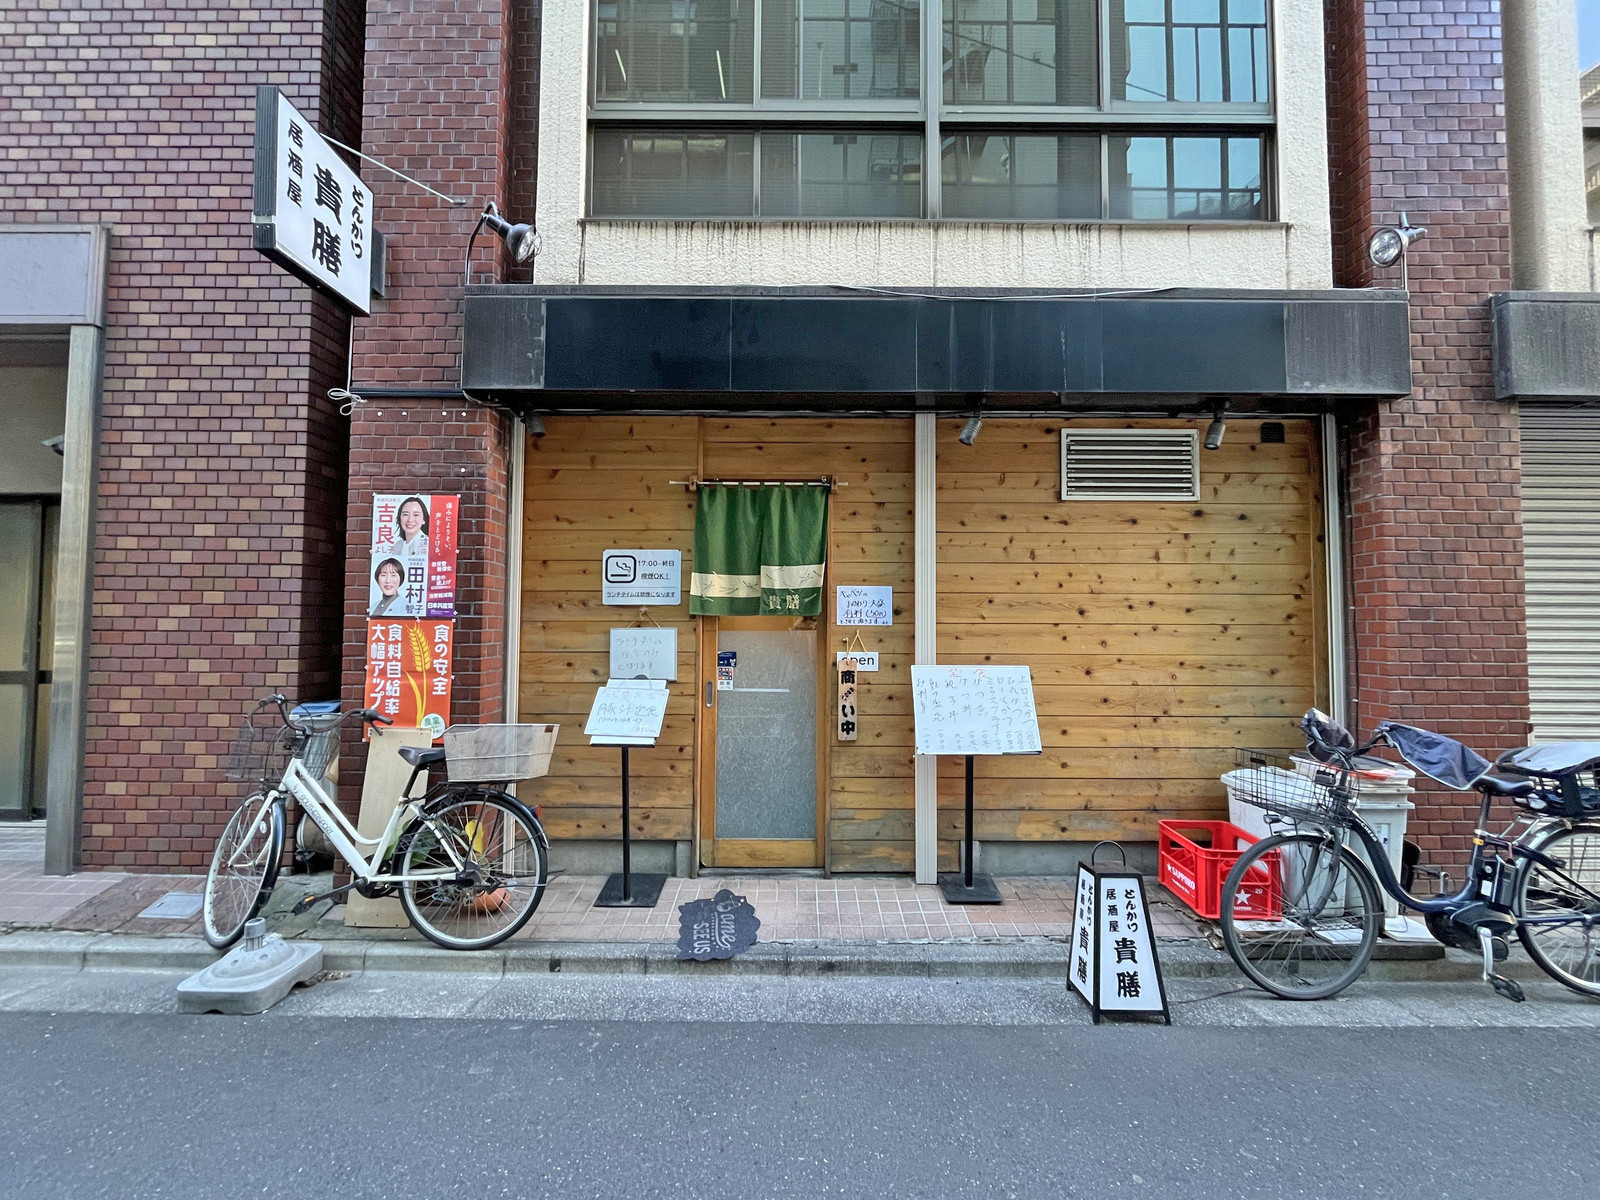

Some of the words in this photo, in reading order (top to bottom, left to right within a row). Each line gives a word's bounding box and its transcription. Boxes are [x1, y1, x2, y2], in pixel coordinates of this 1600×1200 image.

[286, 118, 304, 209] 居酒屋
[312, 163, 343, 278] 貴膳
[350, 184, 365, 260] とんかつ
[375, 503, 396, 544] 吉良
[374, 545, 395, 554] よし子
[405, 567, 424, 604] 田村
[769, 594, 800, 610] 貴膳
[405, 604, 424, 614] 智子
[370, 623, 386, 710] 大幅アップ
[385, 623, 403, 715] 食料自給率
[432, 624, 450, 695] 食の安全
[693, 922, 710, 940] SEE
[1106, 888, 1120, 932] 居酒屋
[1124, 888, 1138, 933] とんかつ
[693, 940, 711, 954] US
[1113, 937, 1141, 998] 貴膳
